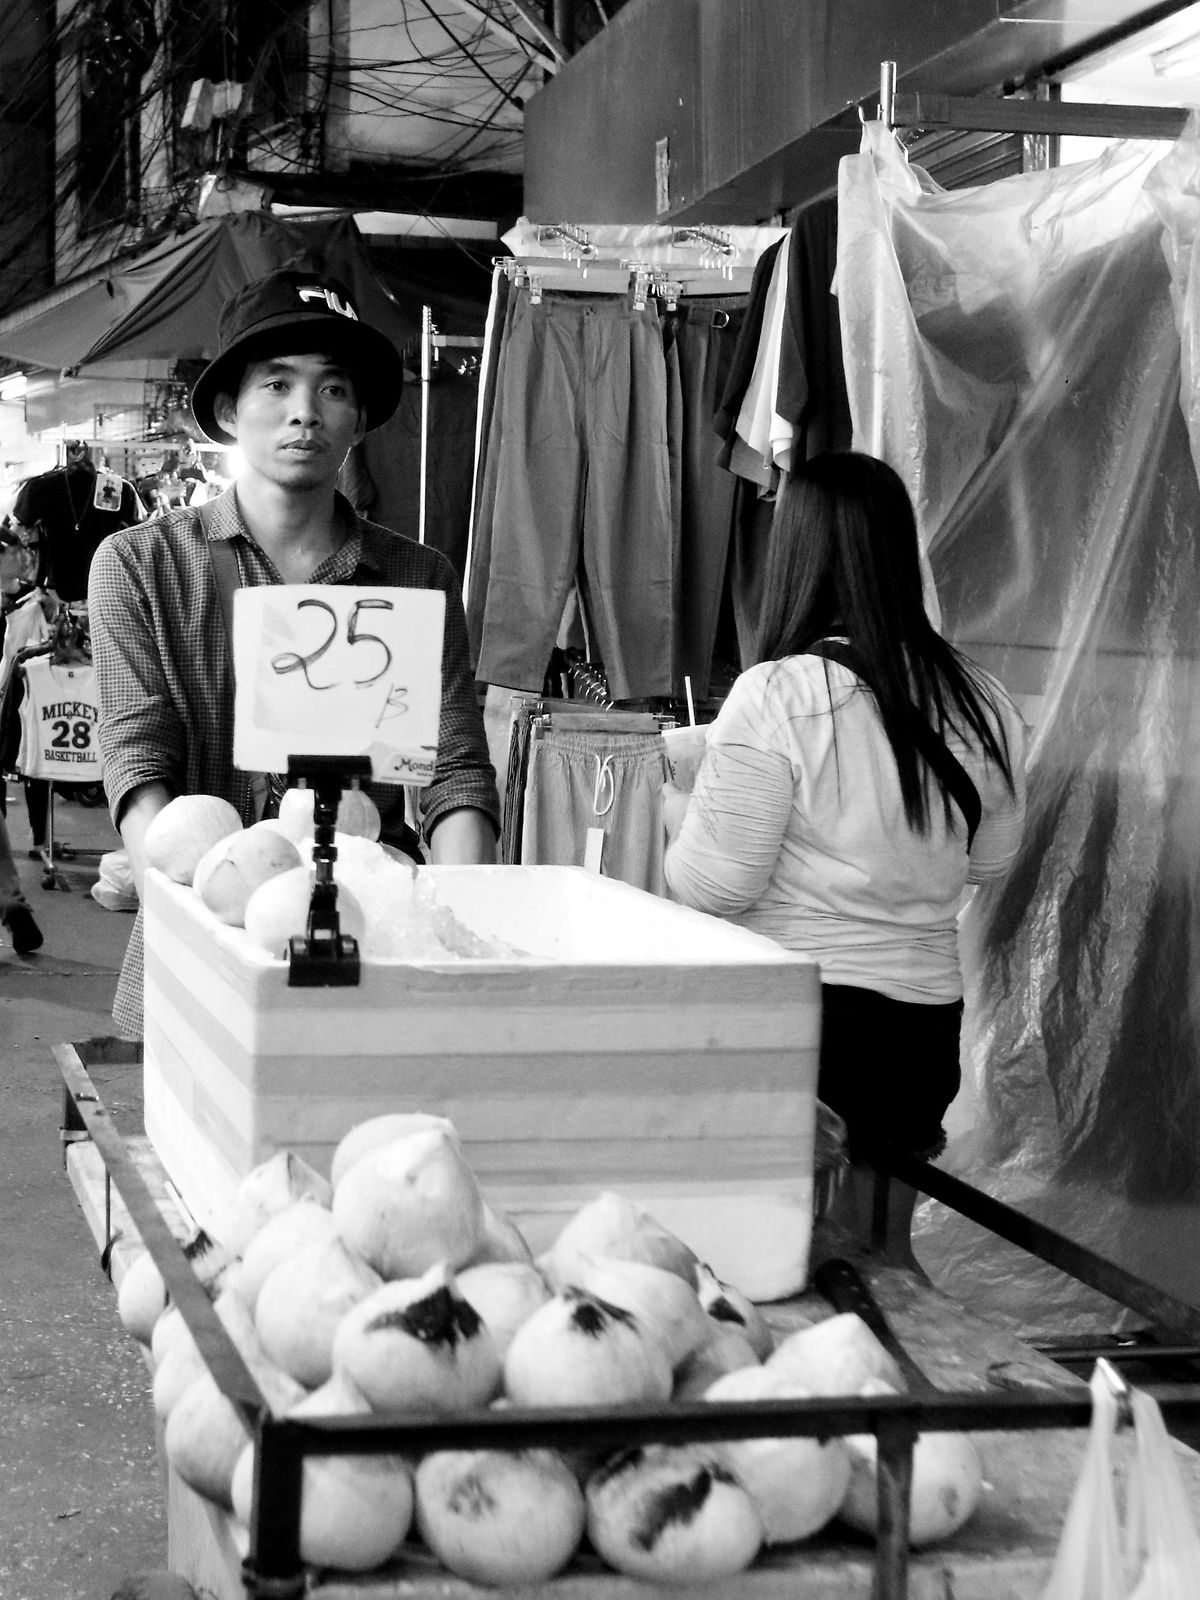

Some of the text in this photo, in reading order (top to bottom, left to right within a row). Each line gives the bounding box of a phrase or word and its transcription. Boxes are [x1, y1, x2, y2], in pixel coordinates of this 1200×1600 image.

[271, 598, 395, 690] 25
[41, 701, 99, 723] MICKEY
[51, 720, 91, 749] 28
[44, 749, 98, 763] BASKETBALL
